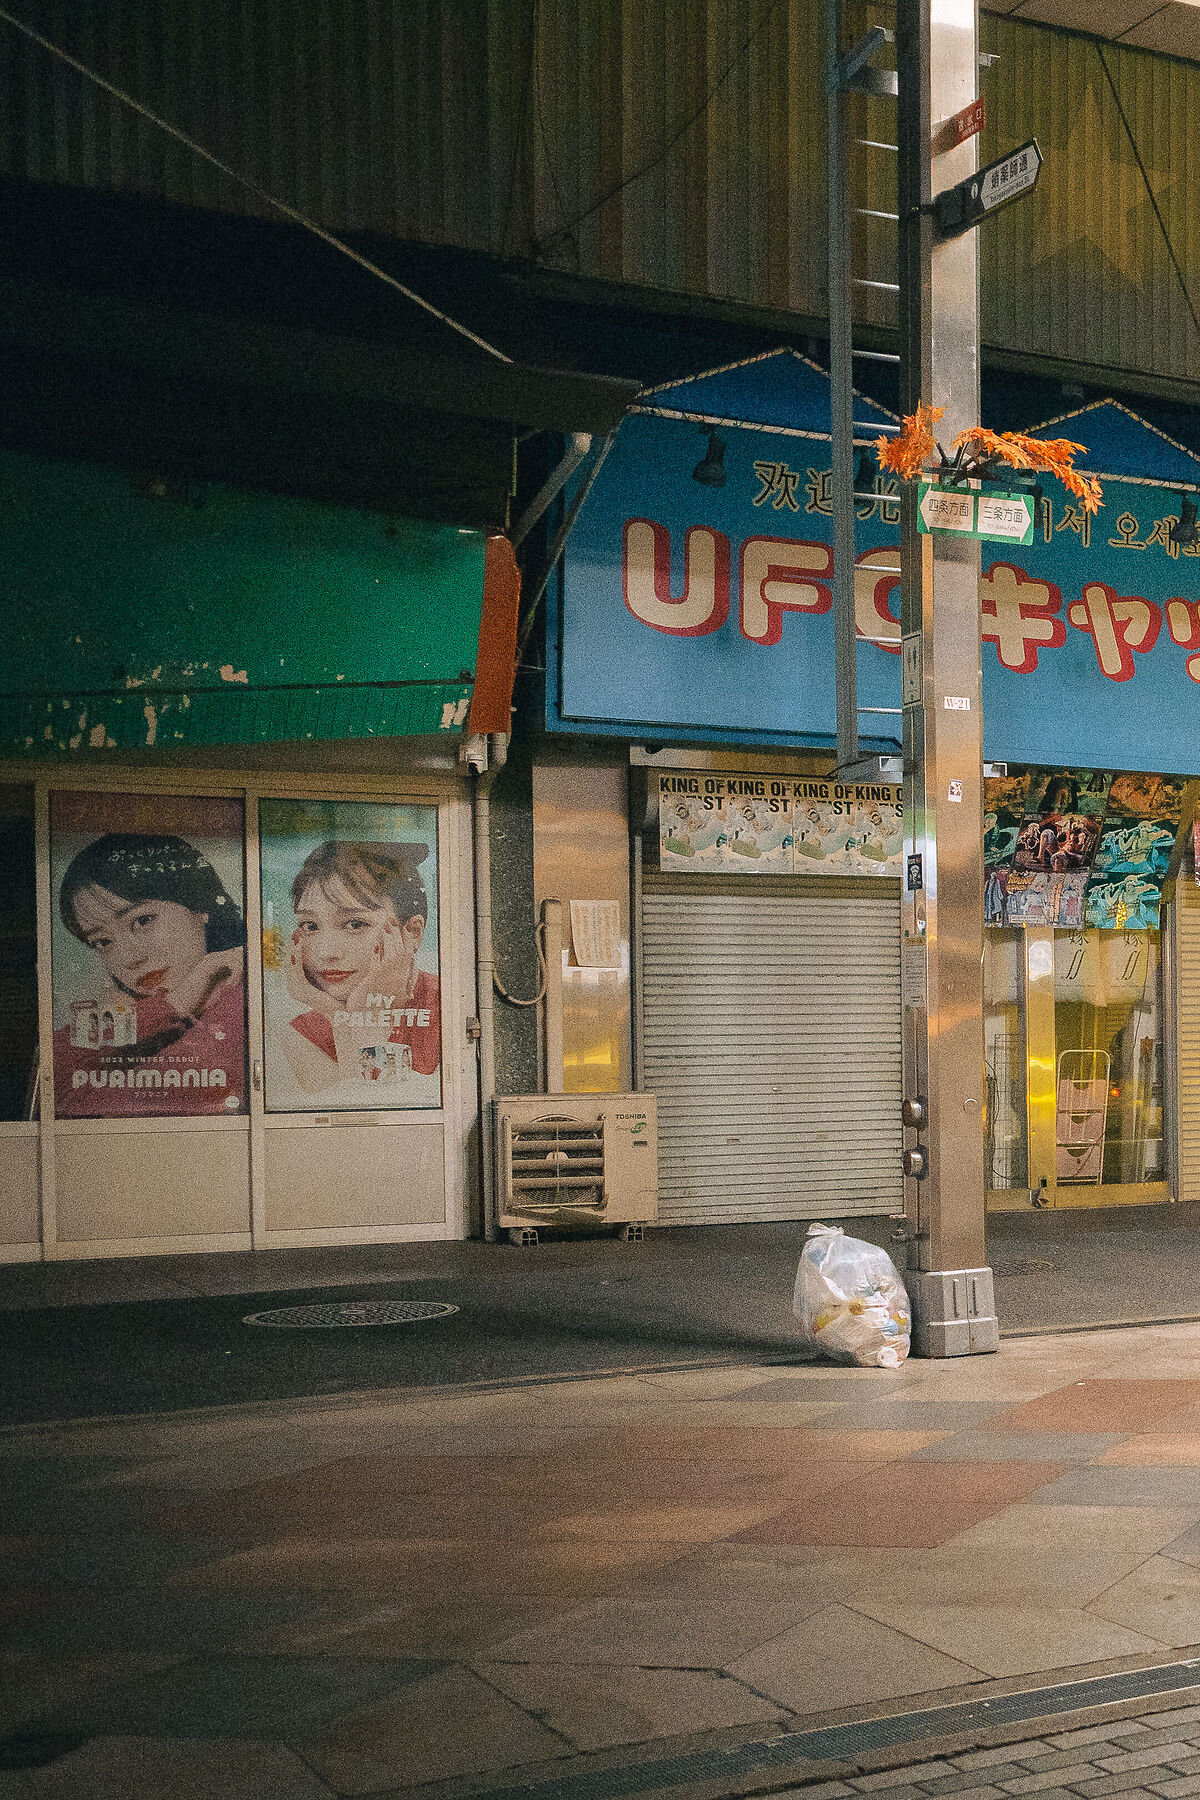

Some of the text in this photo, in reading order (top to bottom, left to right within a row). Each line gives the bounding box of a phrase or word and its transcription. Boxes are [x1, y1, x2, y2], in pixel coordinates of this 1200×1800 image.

[929, 498, 969, 517] 四条方面
[984, 506, 1024, 523] 三条方面
[946, 698, 968, 709] W-21
[660, 777, 726, 794] KING OF
[727, 780, 765, 797] KING
[793, 783, 854, 800] KING OF
[855, 785, 891, 801] KING
[366, 993, 396, 1008] MY
[333, 1008, 431, 1028] PALETTE
[72, 1068, 227, 1089] PURIMANIA
